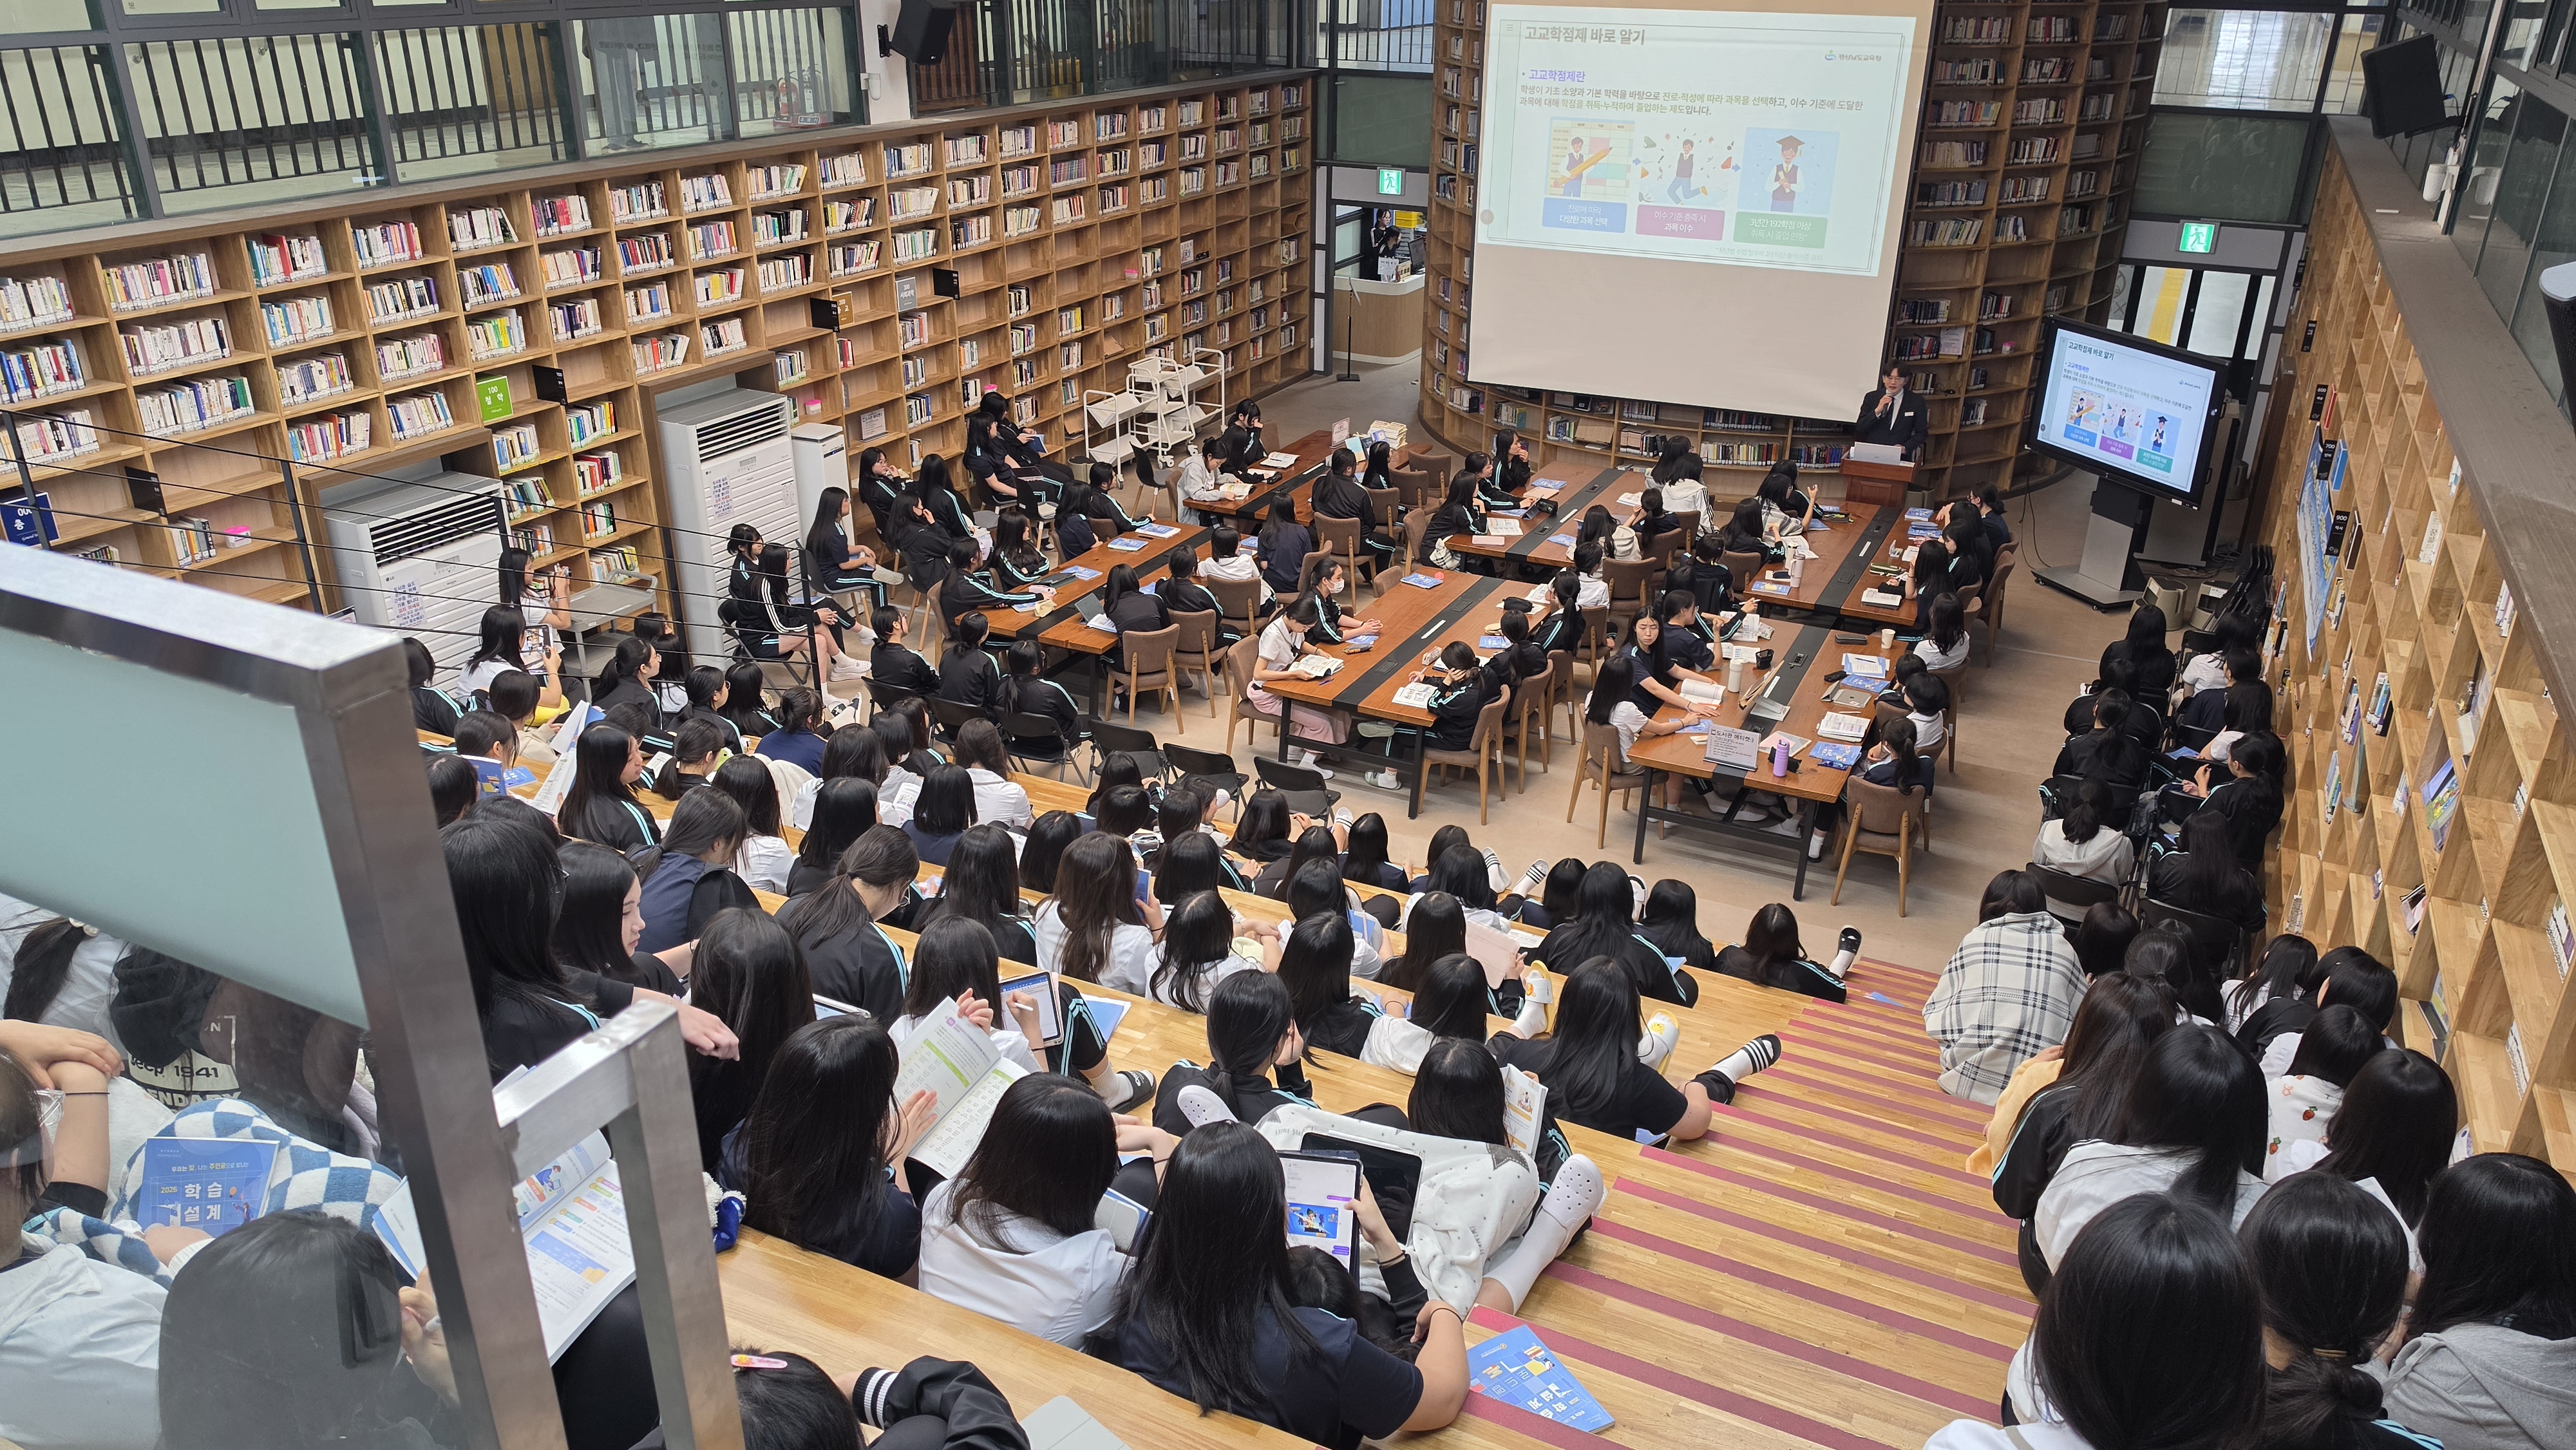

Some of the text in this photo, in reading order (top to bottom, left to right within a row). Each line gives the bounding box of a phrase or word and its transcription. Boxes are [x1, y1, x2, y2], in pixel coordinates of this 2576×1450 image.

[1524, 26, 1645, 45] 고교학점제 바로 알기
[1528, 69, 1586, 82] 고교학점제란
[1520, 85, 1542, 95] 학생이
[1545, 86, 1560, 95] 기초
[1562, 87, 1585, 97] 소양과
[1587, 88, 1602, 98] 기본
[1604, 89, 1627, 99] 학력을
[1629, 90, 1660, 100] 바탕으로
[1707, 95, 1723, 104] 따라
[1725, 95, 1750, 105] 과목을
[1752, 96, 1787, 108] 선택하고,
[1790, 98, 1807, 108] 이수
[1809, 99, 1835, 109] 기준에
[1837, 100, 1863, 111] 도달한
[1519, 97, 1542, 107] 과목에
[1544, 98, 1559, 108] 대해
[1561, 99, 1584, 109] 학점을
[1636, 102, 1667, 113] 졸업하는
[1669, 103, 1711, 116] 제도입니다.
[1588, 205, 1602, 214] 따라
[1559, 214, 1608, 226] 다양한 과목 선택
[1654, 211, 1667, 220] 이수
[1669, 212, 1683, 221] 기준
[1698, 214, 1706, 223] 시
[1664, 223, 1694, 233] 과목 이수
[1750, 218, 1812, 231] 3년간 192학점 이상
[1766, 231, 1774, 239] 시
[2069, 342, 2114, 361] 고교학점제 바로 알기
[488, 386, 498, 394] 100
[1717, 730, 1732, 739] 도서관
[175, 1065, 219, 1078] 1941
